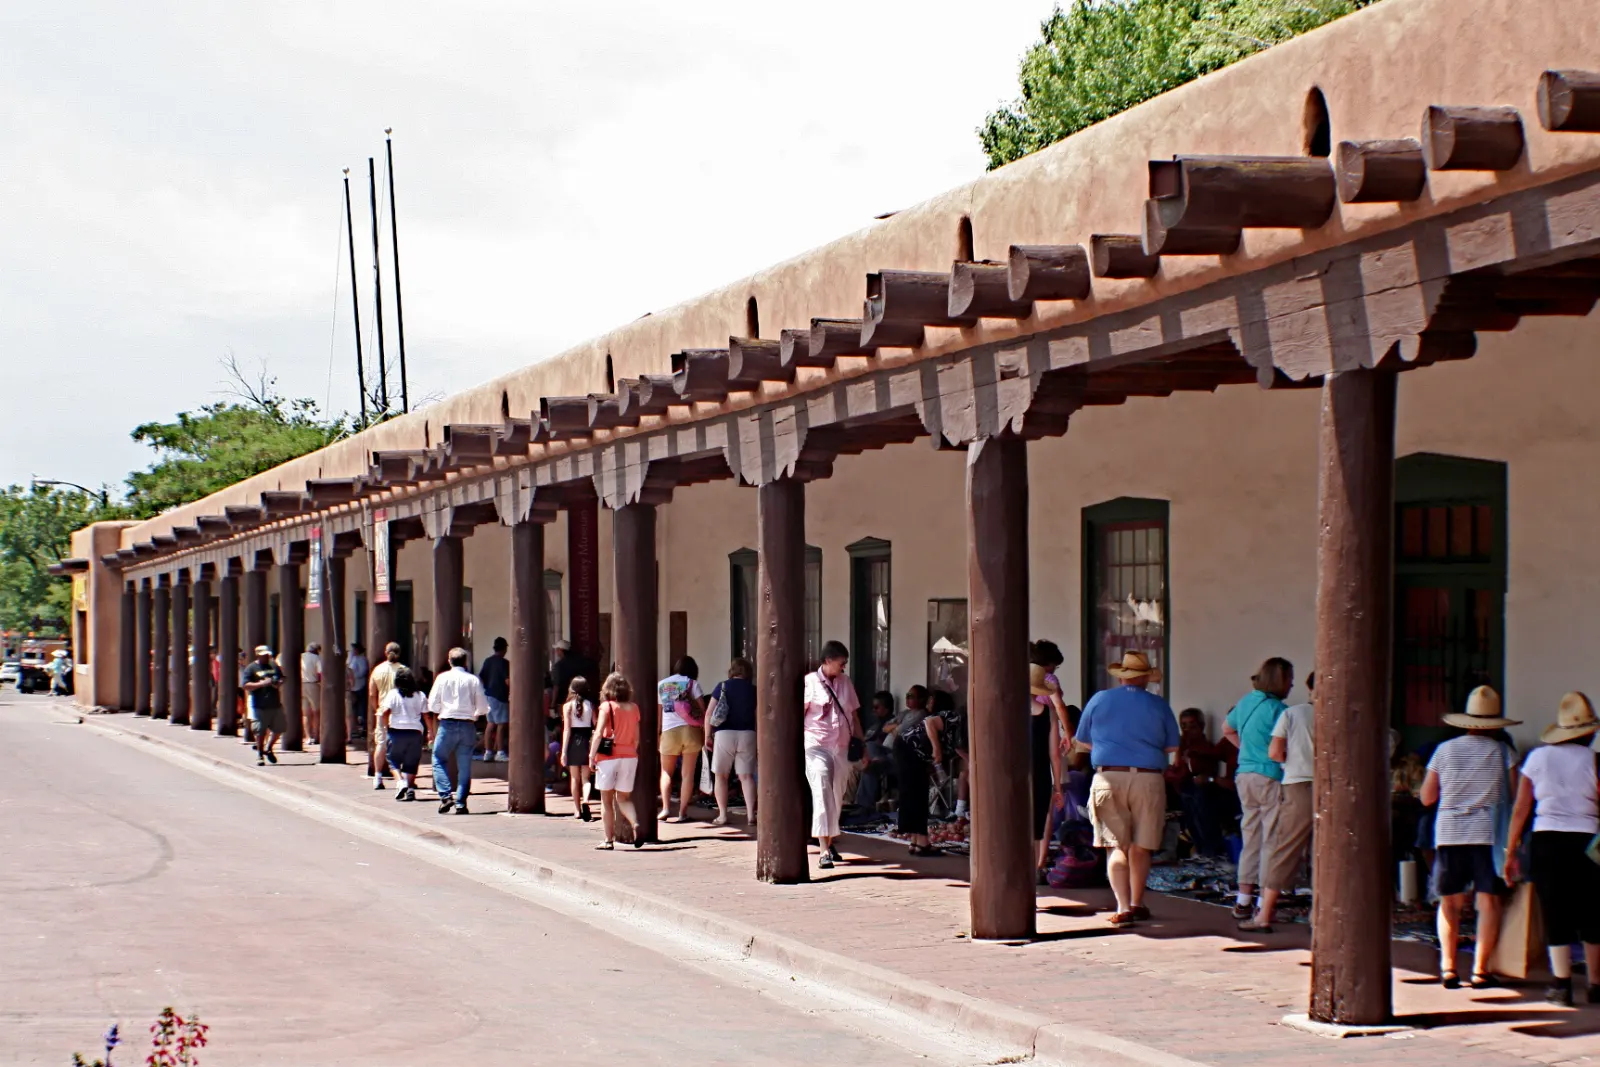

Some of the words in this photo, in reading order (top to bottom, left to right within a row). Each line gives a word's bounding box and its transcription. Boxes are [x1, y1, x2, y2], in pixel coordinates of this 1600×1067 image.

[578, 509, 590, 555] Museum
[578, 557, 591, 599] History
[579, 601, 590, 641] Mexico
